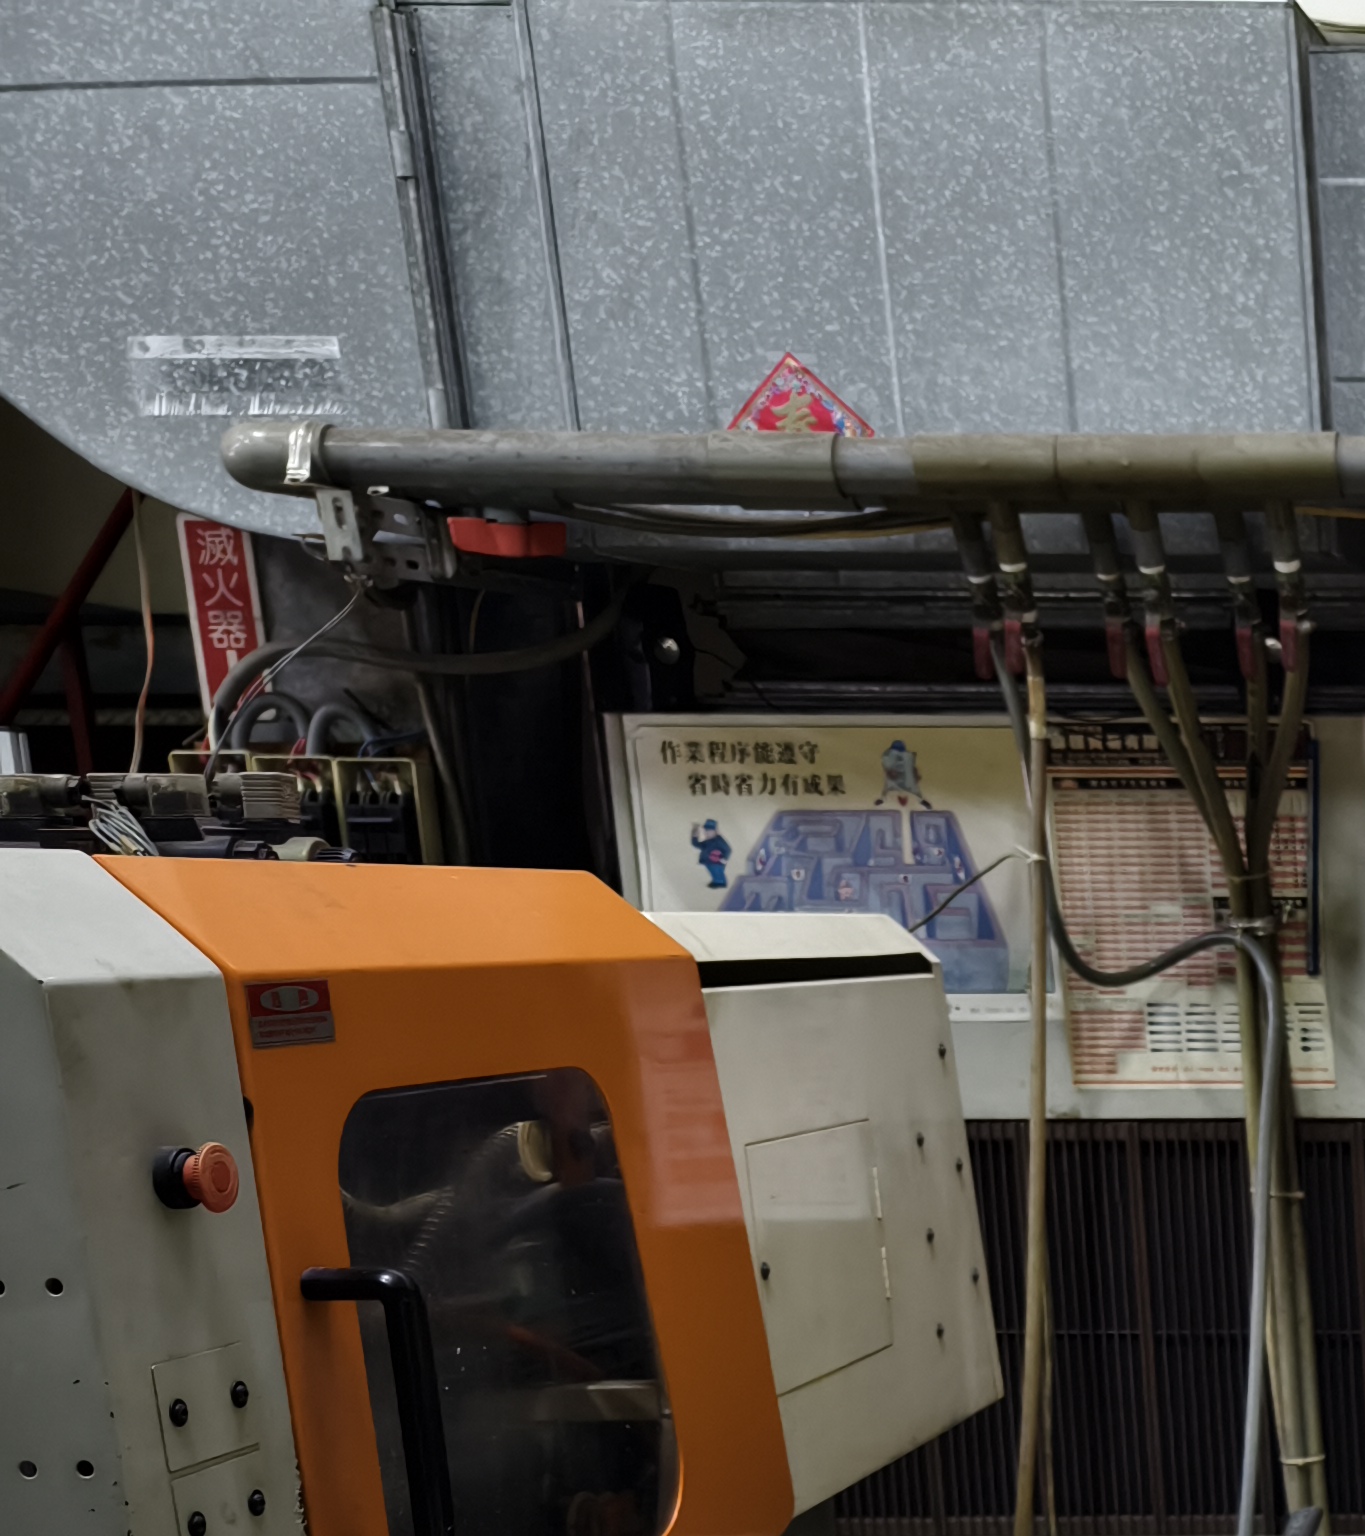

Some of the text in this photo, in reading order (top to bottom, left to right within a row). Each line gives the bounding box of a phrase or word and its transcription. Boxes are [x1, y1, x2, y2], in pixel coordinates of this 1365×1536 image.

[195, 526, 248, 649] 滅火器
[687, 772, 847, 797] 省時省力有成果
